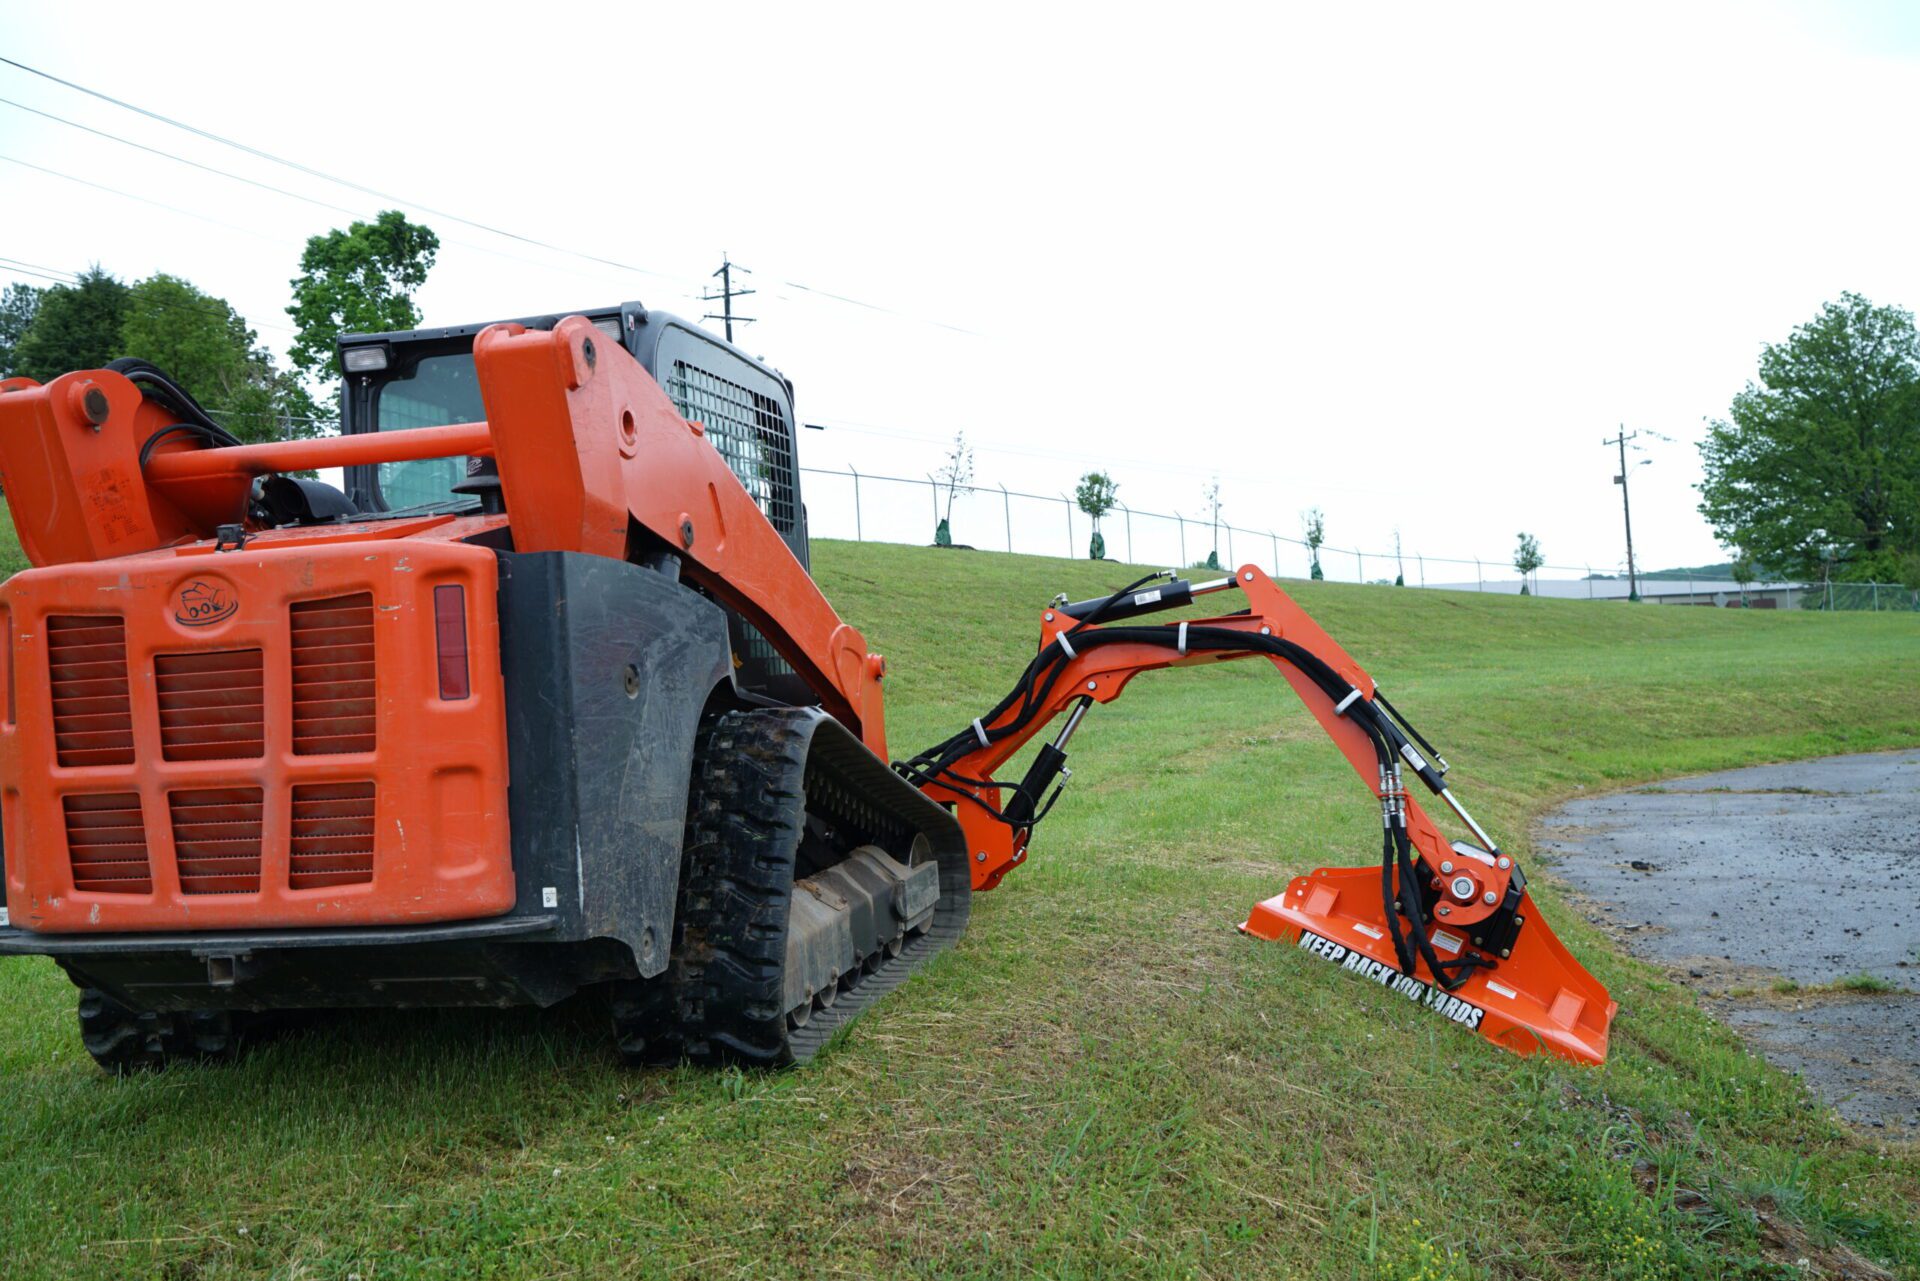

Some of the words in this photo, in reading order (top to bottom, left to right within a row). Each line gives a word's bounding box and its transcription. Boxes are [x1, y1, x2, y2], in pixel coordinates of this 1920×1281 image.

[1299, 931, 1346, 962] KEEP
[1341, 951, 1396, 985] BACK
[1391, 973, 1425, 1001] 100
[1422, 986, 1484, 1028] YARDS
